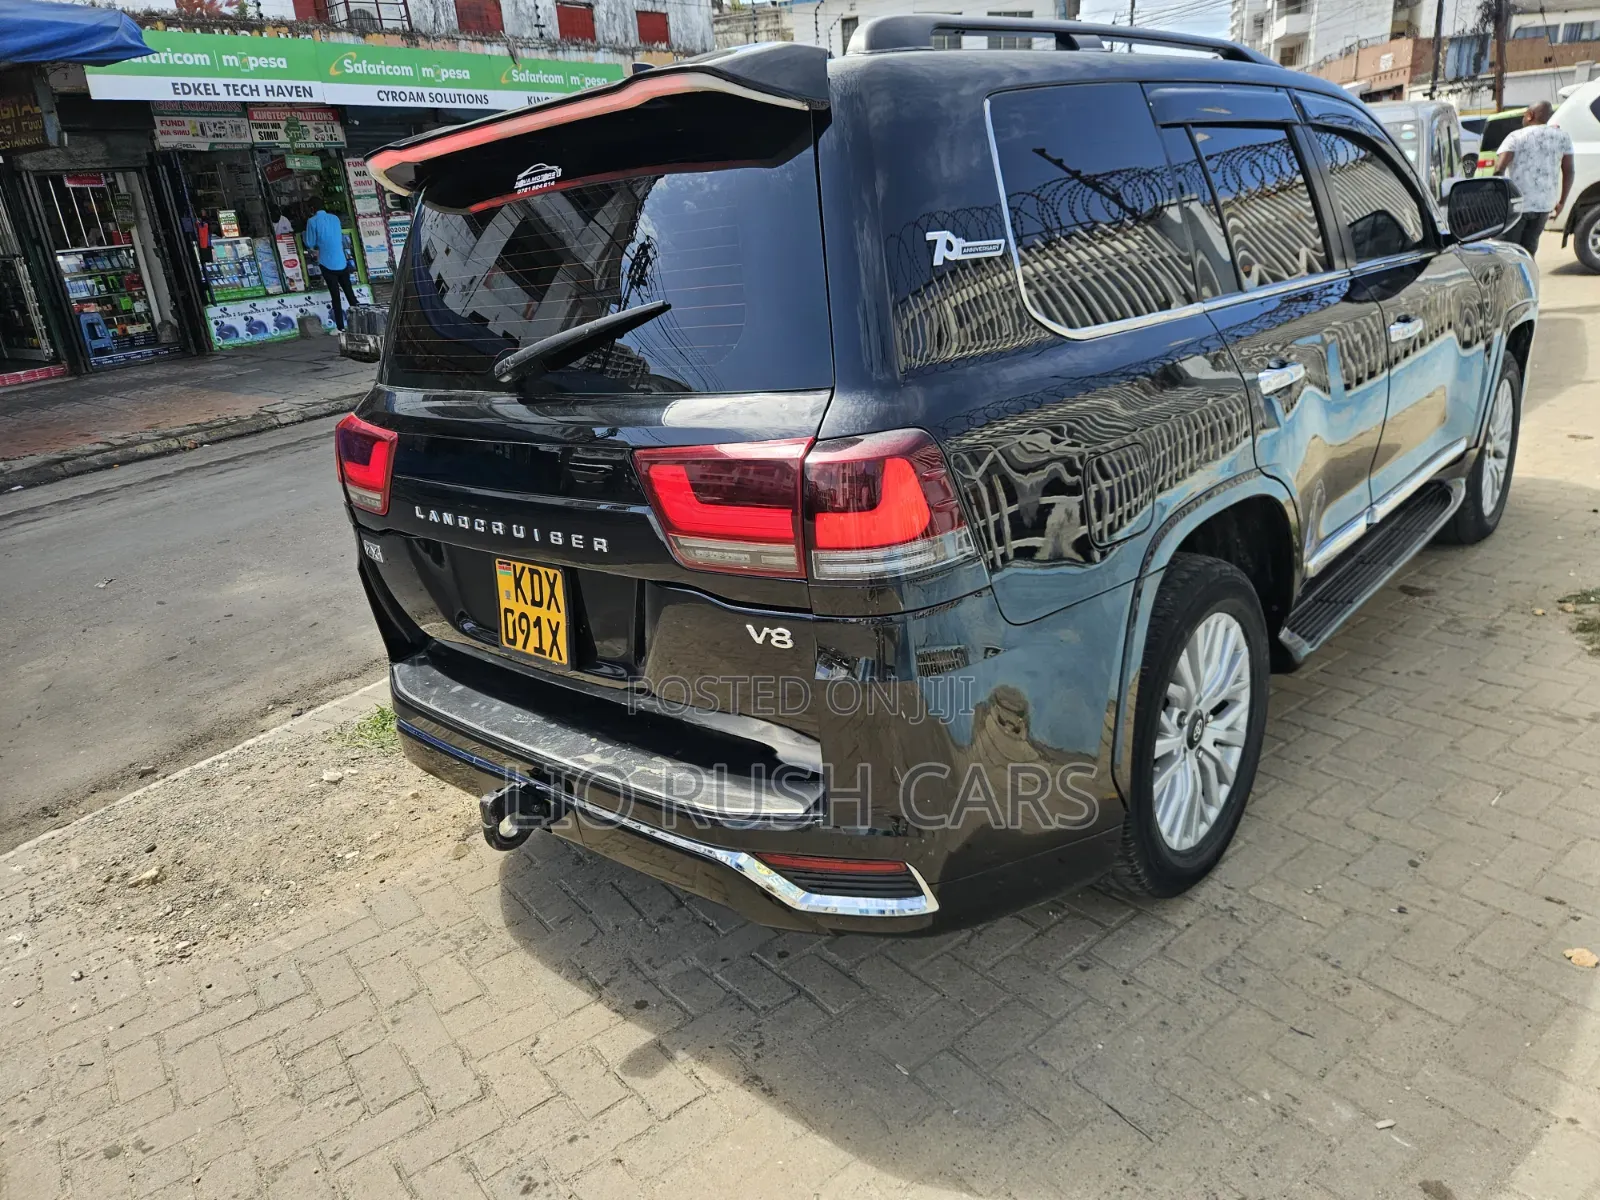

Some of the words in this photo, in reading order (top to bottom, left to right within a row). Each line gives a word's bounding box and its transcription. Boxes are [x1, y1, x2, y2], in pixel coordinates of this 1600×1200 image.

[343, 59, 413, 77] Safaricom
[512, 69, 564, 84] Safaricom
[171, 82, 220, 96] EDKEL
[223, 84, 259, 97] TECH
[265, 84, 313, 98] HAVEN
[376, 90, 426, 104] CYROAM
[428, 92, 489, 105] SOLUTIONS
[160, 119, 185, 127] FUNDI
[291, 111, 334, 121] SOLUTIONS
[251, 122, 270, 130] FUNDI
[270, 122, 282, 130] WA
[258, 131, 279, 141] SIMU
[367, 229, 381, 237] WA
[962, 244, 999, 254] ANNIVERSARY
[513, 564, 561, 613] KDX
[503, 607, 562, 661] 091X
[745, 622, 794, 649] V8
